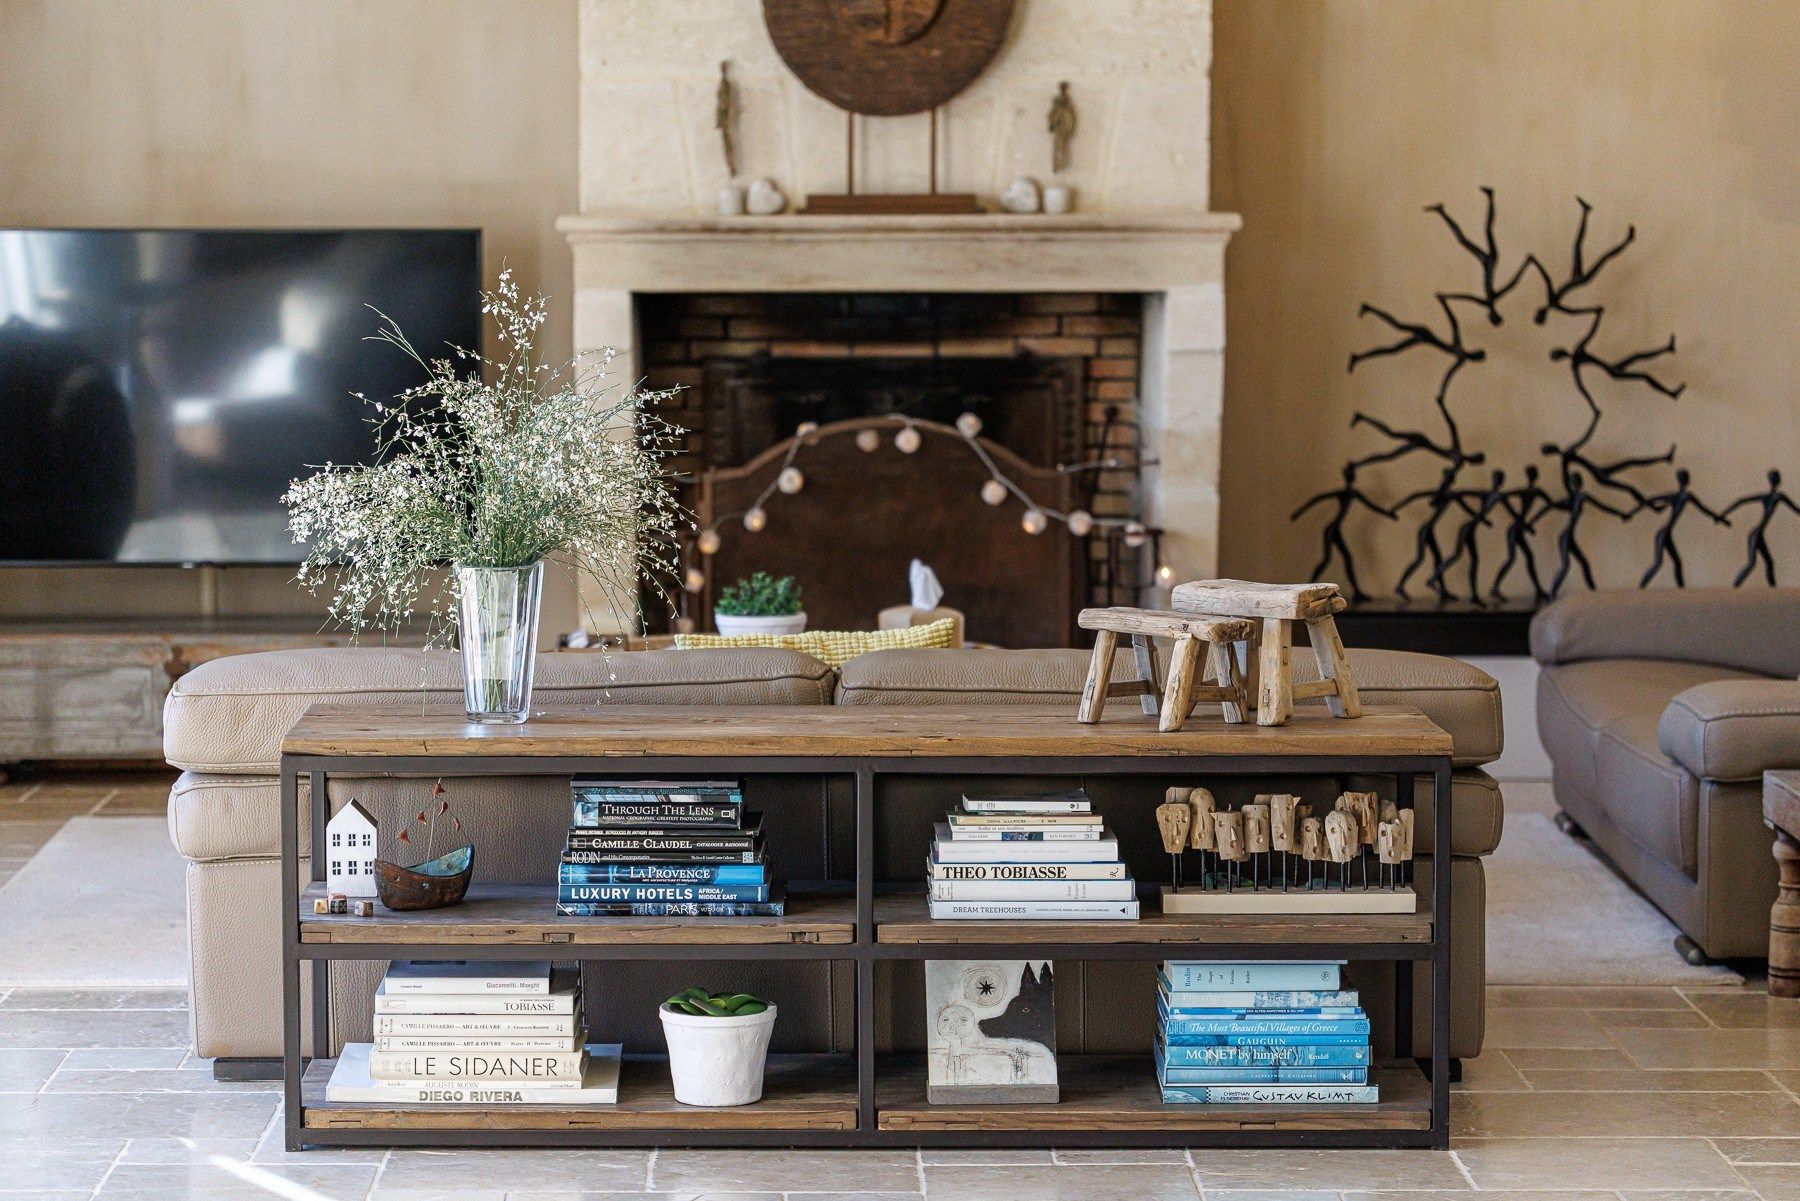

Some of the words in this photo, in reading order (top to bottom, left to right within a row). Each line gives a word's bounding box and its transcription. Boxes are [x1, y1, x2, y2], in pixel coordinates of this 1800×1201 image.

[602, 804, 659, 815] THROUGH
[661, 804, 686, 816] THE
[689, 805, 714, 816] LENS
[592, 838, 640, 849] CAMILLE
[643, 838, 693, 849] CLAUDEL
[571, 851, 601, 864] RODIN
[630, 866, 647, 879] LA
[648, 866, 710, 879] PROVENCE
[942, 866, 986, 879] THEO
[990, 866, 1067, 879] TOBIASSE
[571, 888, 630, 900] LUXURY
[636, 888, 693, 900] HOTELS
[980, 906, 1027, 914] TREEHOUSES
[503, 1002, 555, 1011] TOBIASSE
[1189, 1023, 1206, 1032] The
[1207, 1023, 1227, 1032] Most
[1228, 1022, 1268, 1034] Beautiful
[1269, 1022, 1301, 1034] Villages
[1301, 1022, 1311, 1034] of
[1311, 1022, 1339, 1032] Greece
[1237, 1036, 1286, 1046] GAUGUIN
[1185, 1049, 1237, 1060] MONET
[1238, 1049, 1251, 1063] by
[1252, 1048, 1293, 1060] himself
[414, 1057, 436, 1076] LE
[449, 1057, 558, 1076] SIDANER
[419, 1090, 463, 1102] DIEGO
[470, 1090, 523, 1102] RIVERA
[1252, 1090, 1303, 1102] GUSTAV
[1306, 1092, 1354, 1101] KLIMT
